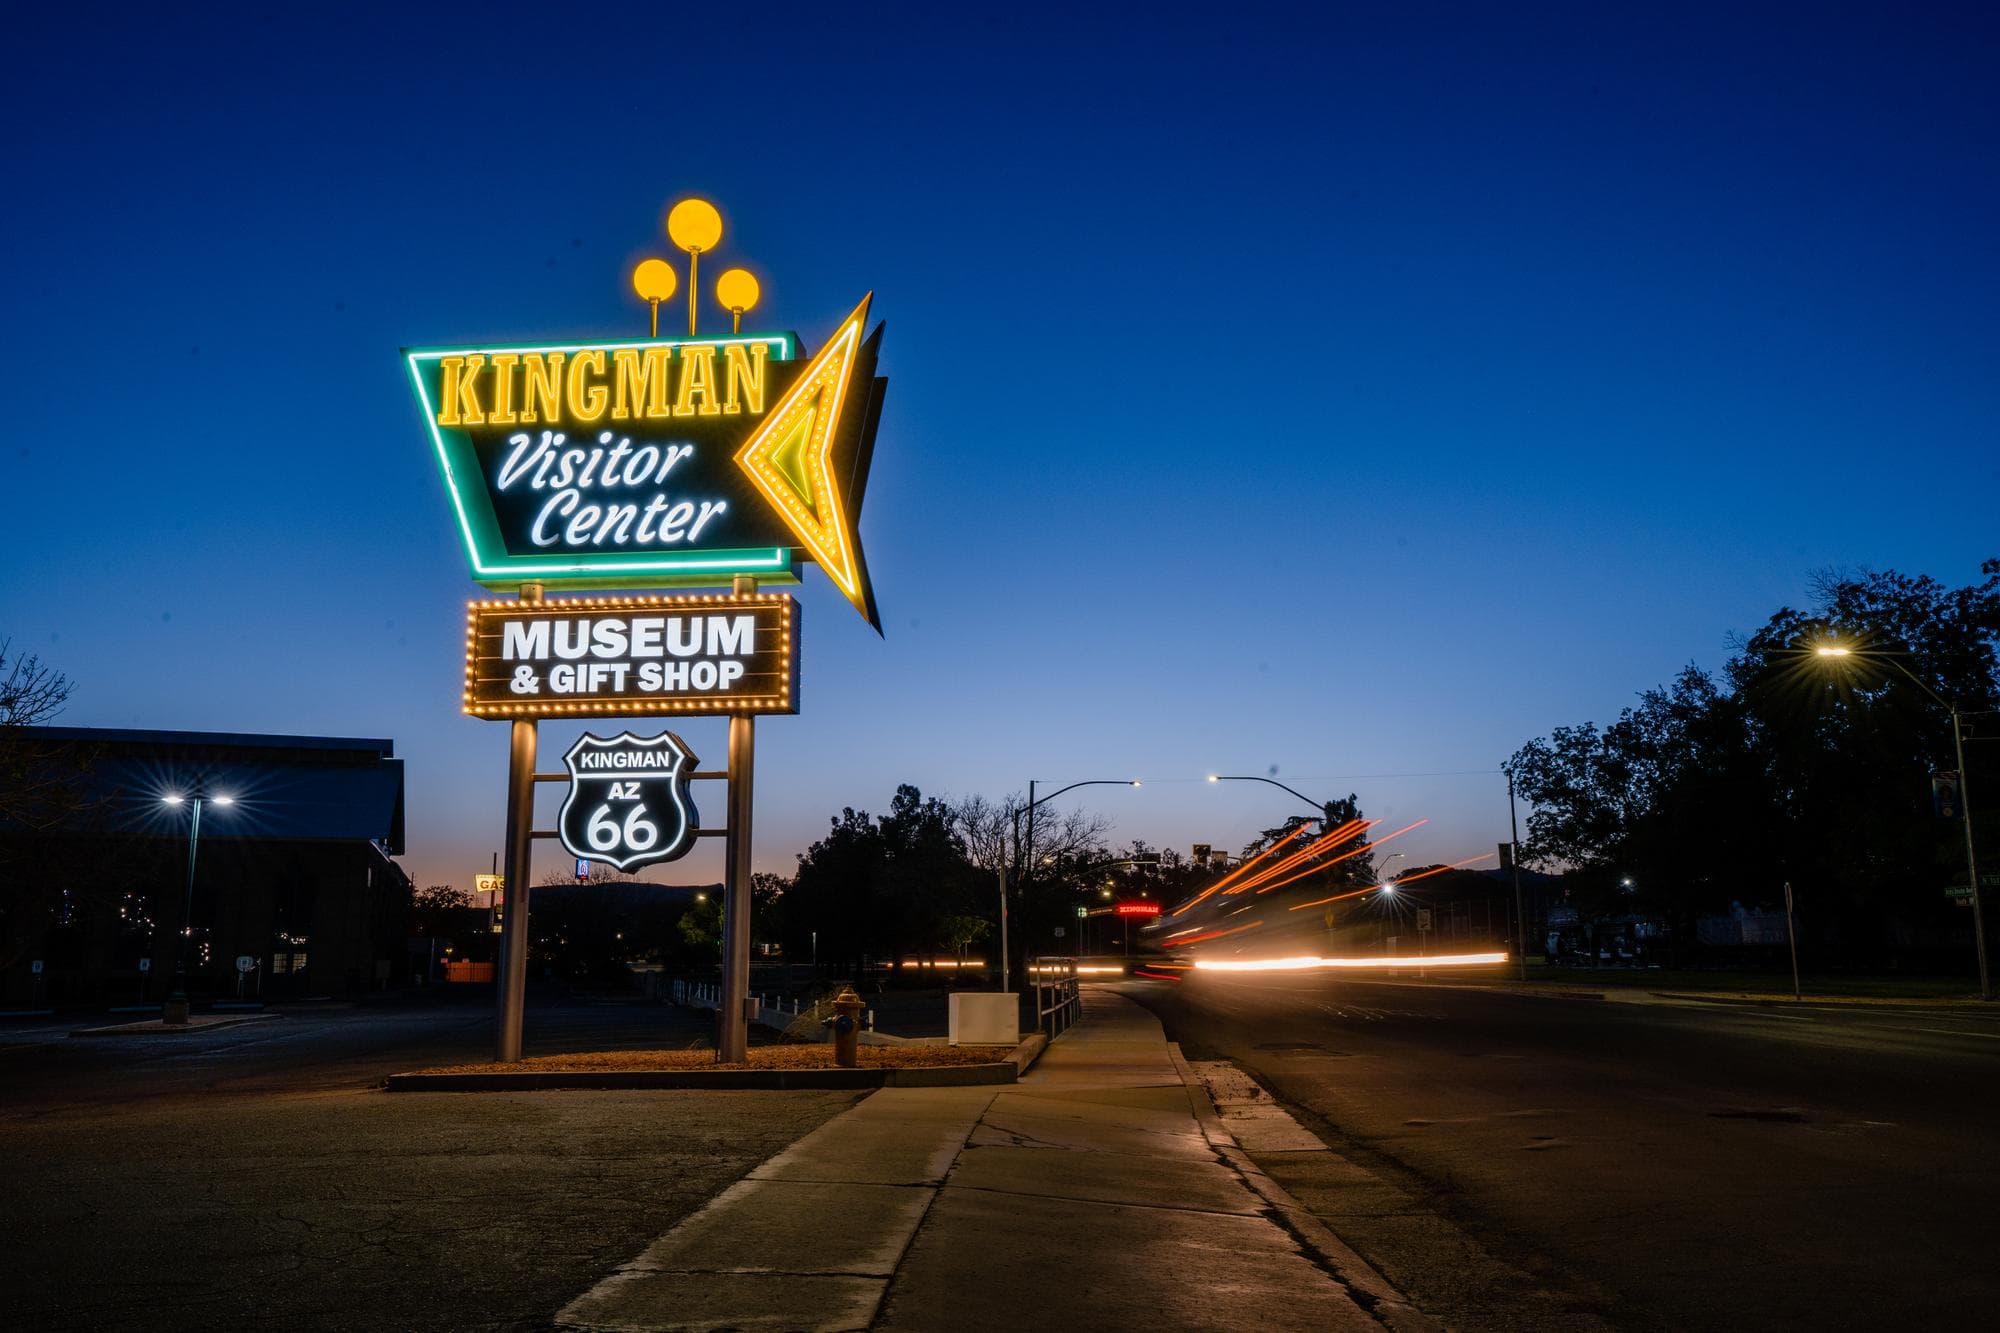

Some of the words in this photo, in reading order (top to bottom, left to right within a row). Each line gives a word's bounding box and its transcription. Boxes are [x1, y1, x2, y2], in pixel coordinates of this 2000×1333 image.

[438, 343, 769, 426] KINGMAN
[497, 430, 694, 492] Visitor
[530, 488, 726, 547] Center
[502, 615, 755, 660] MUSEUM
[510, 665, 539, 694] &
[549, 663, 630, 693] GIFT
[637, 660, 744, 692] SHOP
[580, 751, 669, 768] KINGMAN
[607, 782, 641, 800] AZ
[587, 803, 658, 851] 66
[480, 880, 505, 890] GAS
